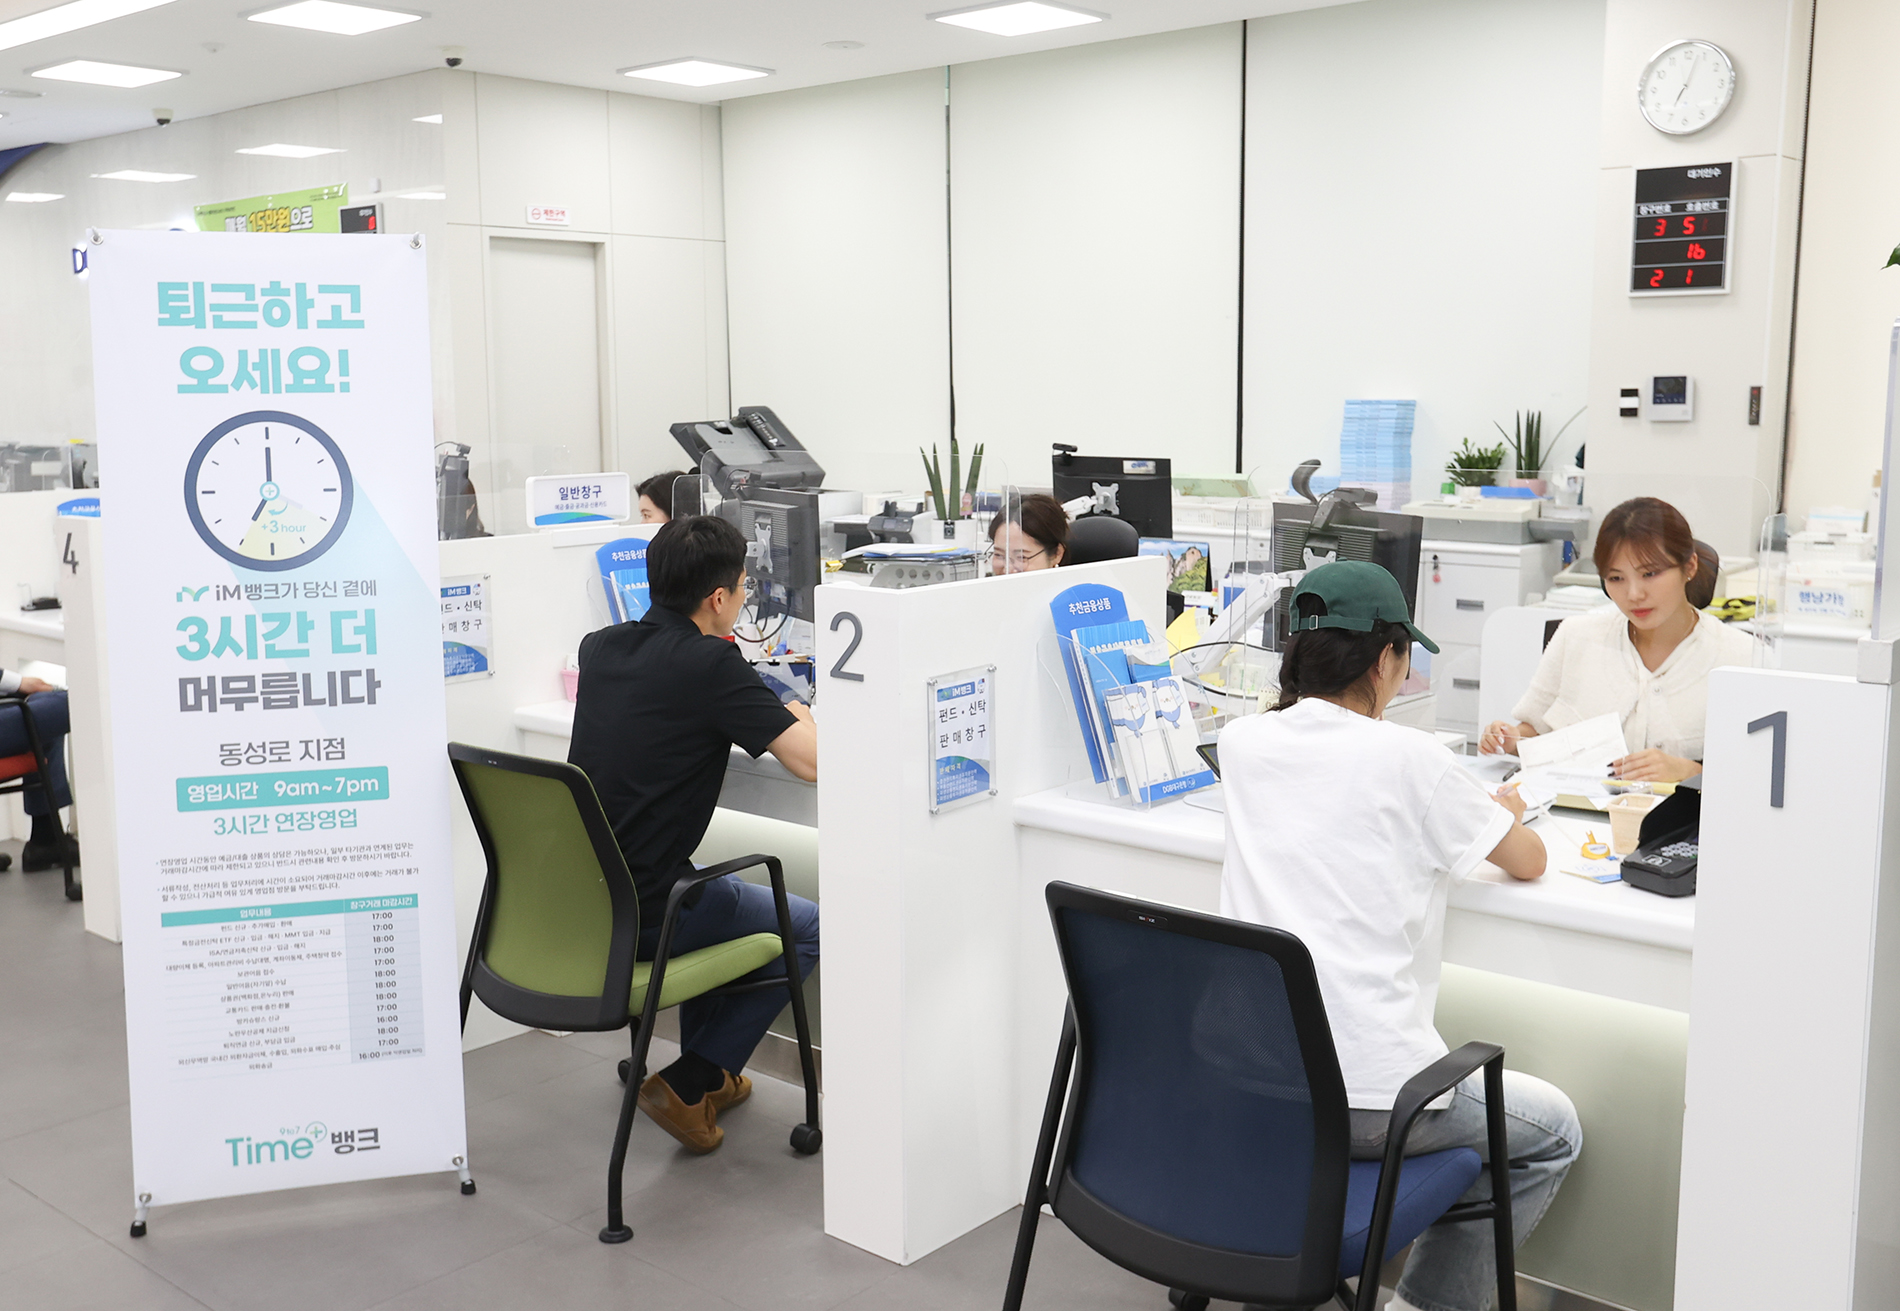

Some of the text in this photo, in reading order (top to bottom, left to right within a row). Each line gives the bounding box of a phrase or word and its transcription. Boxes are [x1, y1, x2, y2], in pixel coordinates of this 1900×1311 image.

[1653, 216, 1696, 237] 3 5
[1649, 268, 1694, 287] 2 1
[157, 281, 365, 330] 퇴근하고
[177, 346, 351, 395] 오세요!
[559, 485, 602, 501] 일반창구
[281, 522, 306, 534] hour
[63, 533, 79, 574] 4
[303, 581, 337, 598] 당신
[342, 580, 377, 598] 곁에
[464, 600, 482, 612] 신탁
[1068, 598, 1112, 615] 추천금융상품
[175, 608, 377, 661] 3시간 더
[829, 611, 864, 682] 2
[178, 668, 381, 713] 머무릅니다
[939, 699, 986, 723] 펀드 신탁
[219, 738, 346, 766] 동성로 지점
[1747, 710, 1788, 809] 1
[187, 776, 379, 803] 영업시간 9am~7pm
[213, 808, 358, 836] 3시간 연장영업
[159, 857, 188, 867] 연장영업
[189, 855, 217, 865] 시간동안
[250, 852, 270, 860] 상품의
[330, 846, 344, 855] 일부
[345, 844, 372, 854] 타기관과
[373, 843, 392, 852] 연계된
[394, 841, 414, 850] 업무는
[160, 865, 209, 876] 거래마감시간에
[210, 864, 224, 872] 따라
[226, 862, 252, 871] 제한되고
[254, 860, 275, 869] 있으니
[276, 859, 296, 868] 반드시
[326, 856, 340, 864] 확인
[341, 855, 348, 863] 후
[349, 853, 382, 862] 방문하시기
[383, 851, 412, 860] 바랍니다.
[193, 882, 220, 891] 전산처리
[230, 878, 264, 889] 업무처리에
[266, 877, 286, 886] 시간이
[288, 875, 314, 885] 소요되어
[316, 872, 356, 883] 거래마감시간
[357, 870, 383, 880] 이후에는
[384, 869, 404, 878] 거래가
[405, 868, 419, 876] 불가
[179, 892, 200, 901] 있으니
[202, 891, 222, 899] 가급적
[224, 890, 237, 898] 여유
[239, 889, 253, 897] 있게
[298, 883, 340, 892] 부탁드립니다.
[350, 896, 413, 911] 창구거래 마감시간
[240, 907, 272, 919] 업무내용
[372, 912, 393, 920] 17:00
[234, 924, 246, 932] 신규
[372, 923, 394, 932] 17:00
[233, 935, 246, 943] 신규
[284, 930, 301, 939] MMT
[373, 934, 395, 943] 18:00
[260, 945, 272, 953] 신규
[374, 946, 395, 955] 17:00
[374, 957, 396, 966] 17:00
[375, 969, 397, 978] 18:00
[375, 980, 397, 989] 18:00
[376, 992, 398, 1000] 18:00
[376, 1003, 398, 1012] 17:00
[377, 1015, 399, 1023] 16:00
[377, 1026, 399, 1035] 18:00
[378, 1037, 400, 1046] 17:00
[358, 1051, 381, 1060] 16:00
[225, 1128, 380, 1166] Time 뱅크
